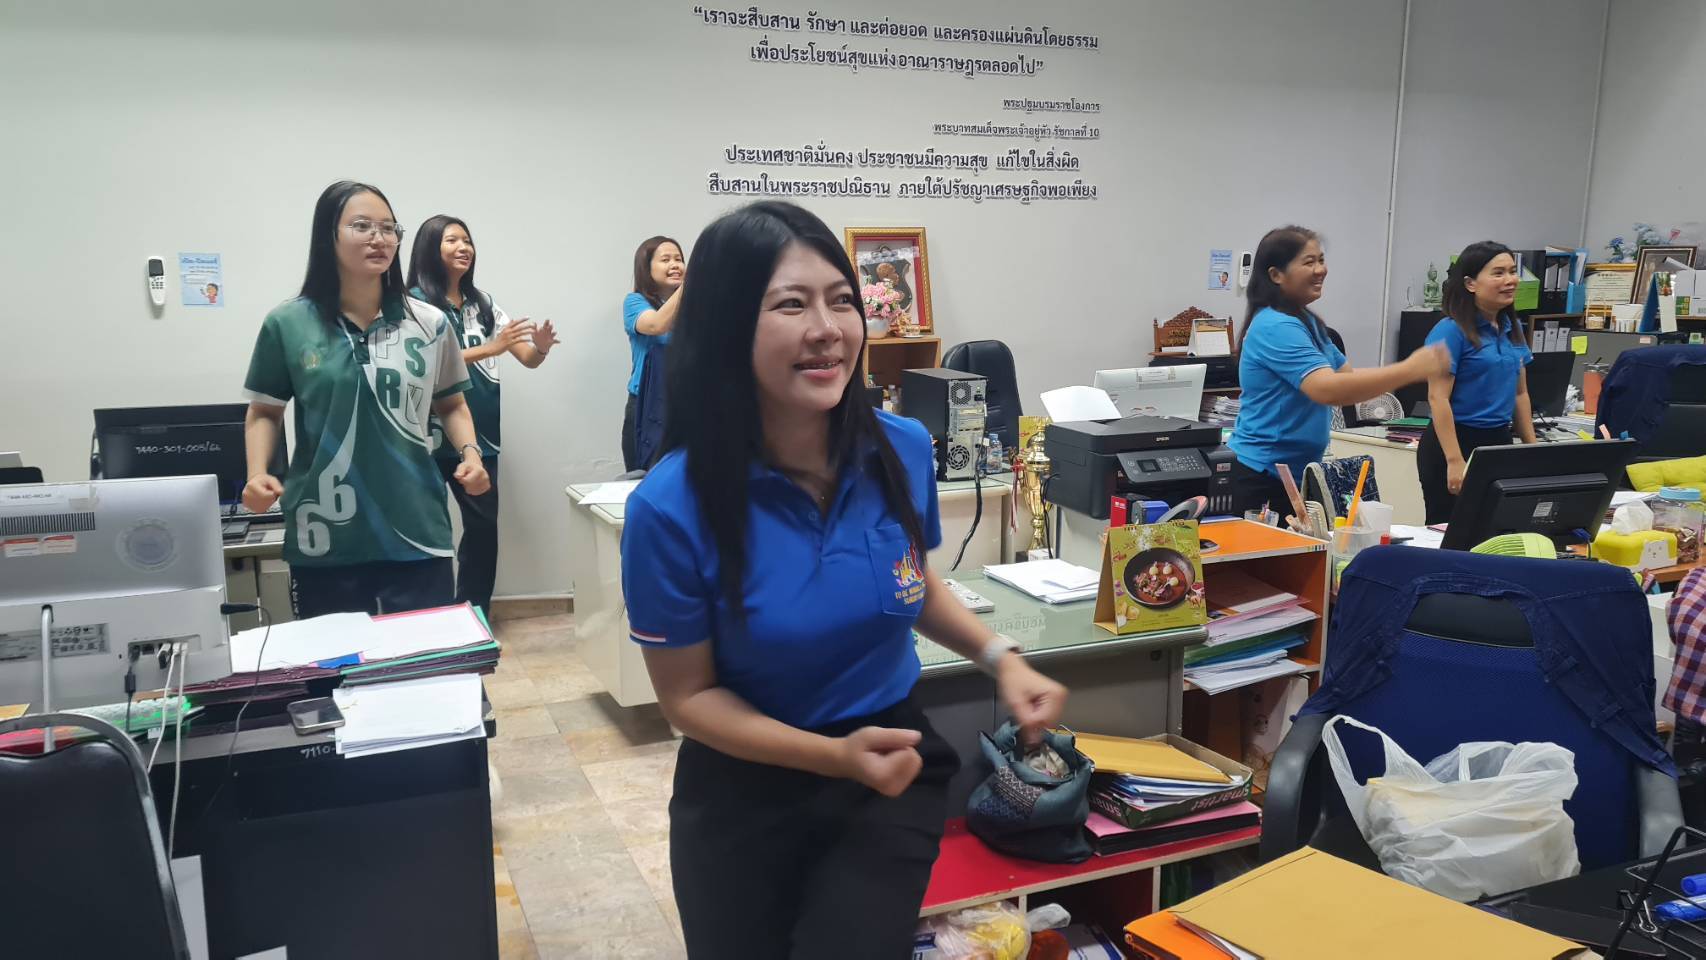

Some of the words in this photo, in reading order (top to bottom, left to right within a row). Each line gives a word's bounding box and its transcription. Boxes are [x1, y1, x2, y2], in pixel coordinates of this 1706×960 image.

[806, 11, 846, 33] รักษา
[851, 16, 928, 38] และต่อยอด
[933, 24, 1099, 49] และครองแผ่นดินโดยธรรม
[1089, 128, 1100, 138] 10
[725, 140, 853, 165] ประเทศชาติมั่นคง
[856, 148, 988, 174] ประชาชนมีความสุข
[996, 146, 1080, 169] แก้ไขในสิ่งผิด
[898, 175, 1098, 203] ภายใต้ปรัชญาเศรษฐกิจพอเพียง
